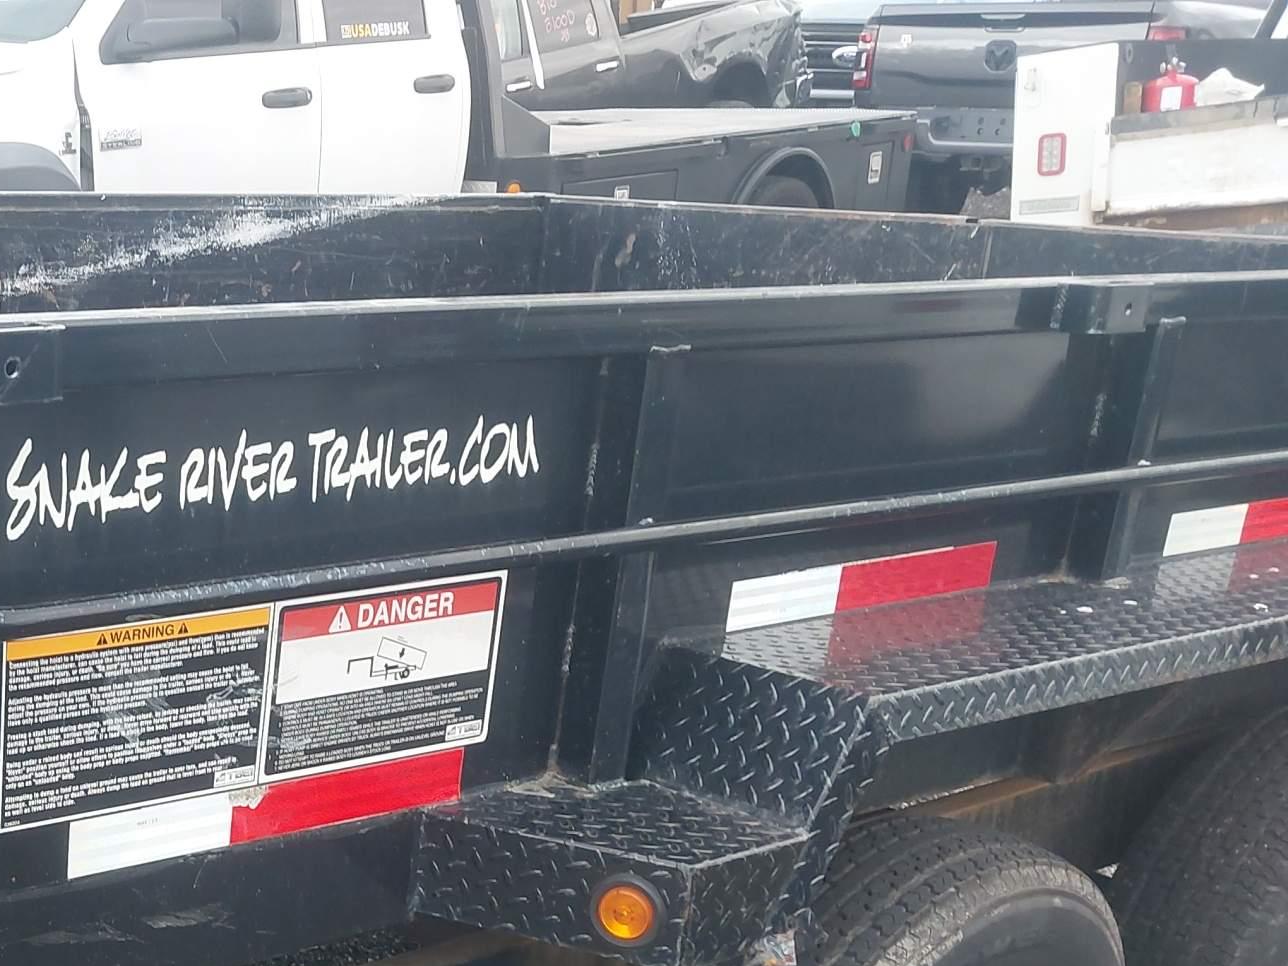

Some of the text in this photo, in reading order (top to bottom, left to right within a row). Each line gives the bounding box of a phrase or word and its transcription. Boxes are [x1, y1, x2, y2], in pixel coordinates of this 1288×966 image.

[351, 21, 410, 39] USADEBUSK
[6, 414, 540, 542] SNAKE RIVER TRAILER.COM
[357, 591, 455, 629] DANGER
[110, 623, 175, 644] WARNING
